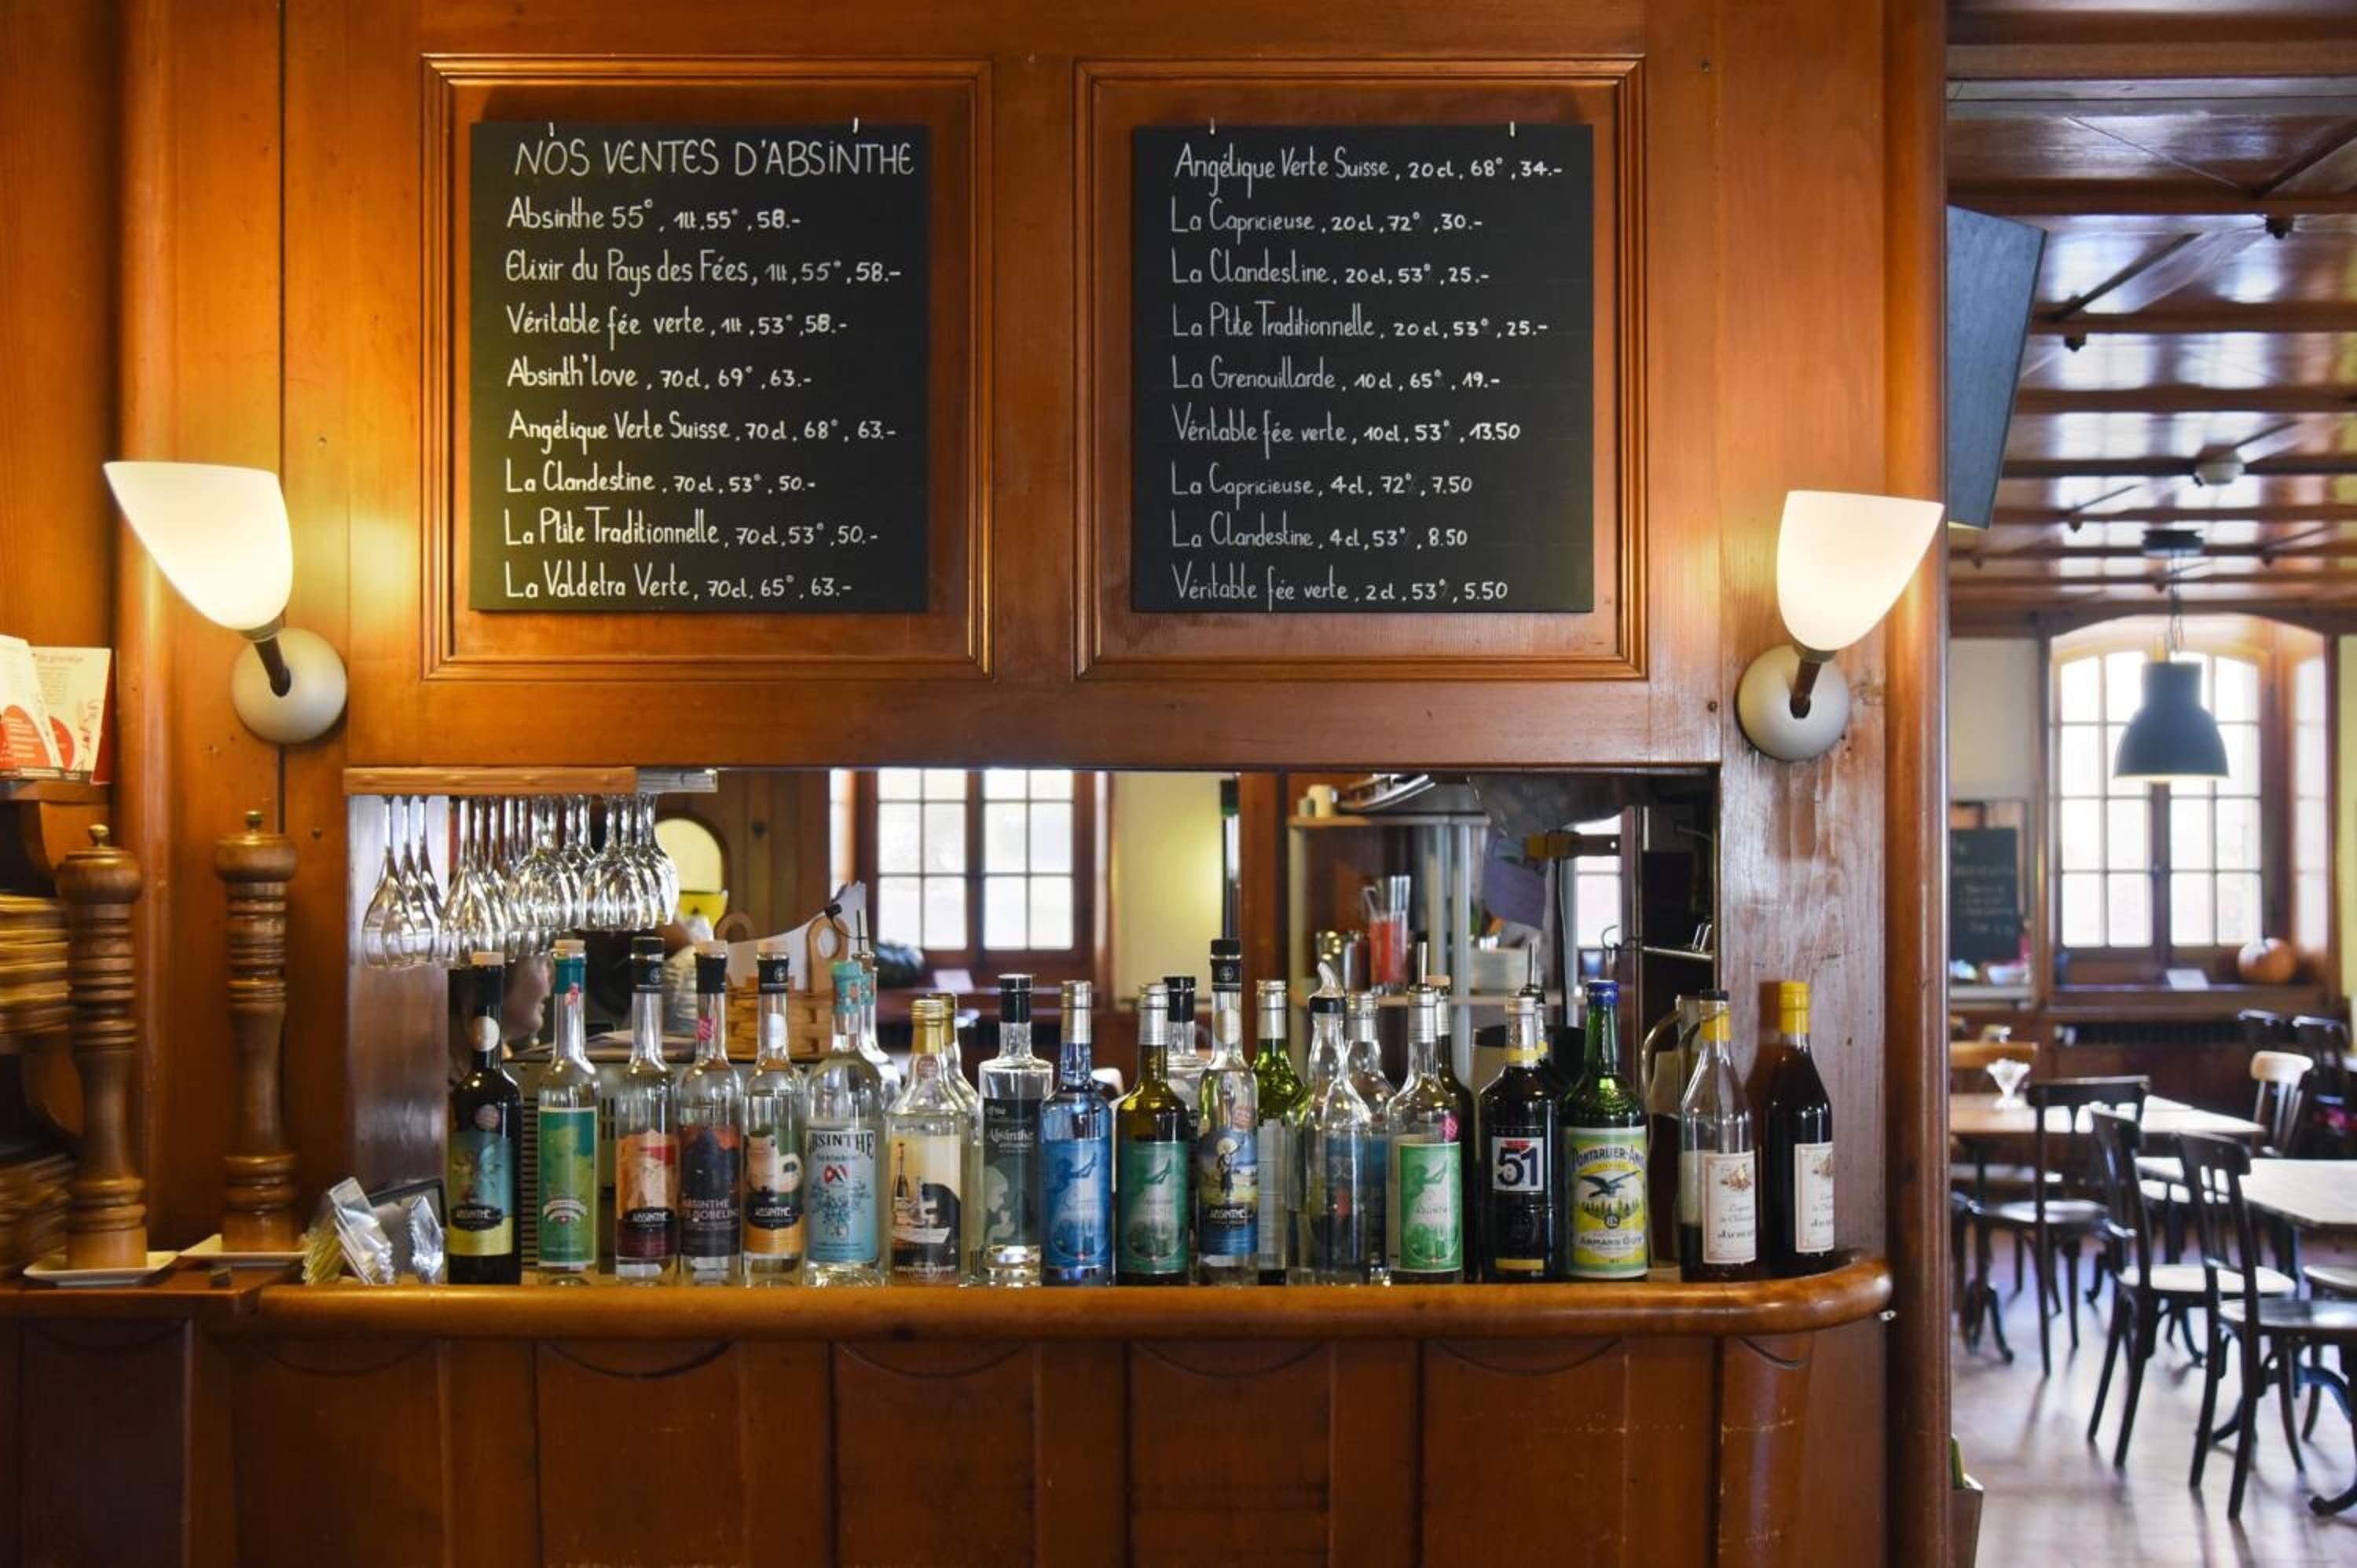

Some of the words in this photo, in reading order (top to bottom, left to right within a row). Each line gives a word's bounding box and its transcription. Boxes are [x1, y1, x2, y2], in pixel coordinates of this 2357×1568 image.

[515, 138, 591, 178] NOS
[604, 138, 720, 177] VENTES
[1281, 146, 1329, 178] Verte
[507, 196, 606, 230] Absinthe
[1171, 196, 1203, 234] La
[506, 249, 566, 283] Elixir
[572, 248, 599, 282] du
[608, 248, 653, 299] Pays
[657, 249, 695, 283] des
[1171, 248, 1204, 284] La
[506, 302, 601, 335] Véritable
[607, 306, 643, 353] fée
[1173, 304, 1204, 338] La
[1172, 355, 1204, 390] La
[614, 409, 665, 440] Verte
[1172, 402, 1259, 443] Véritable
[1263, 410, 1295, 461] fée
[1469, 423, 1522, 441] 13.50
[506, 458, 537, 494] La
[1172, 462, 1204, 496] La
[1432, 476, 1474, 495] 7.50
[504, 508, 535, 548] La
[1171, 509, 1204, 548] La
[1428, 528, 1468, 548] 8.50
[505, 561, 540, 600] La
[544, 559, 627, 599] Valdetra
[1172, 561, 1259, 600] Véritable
[1268, 566, 1296, 613] fée
[1464, 581, 1508, 601] 5.50
[1497, 1147, 1537, 1186] 51
